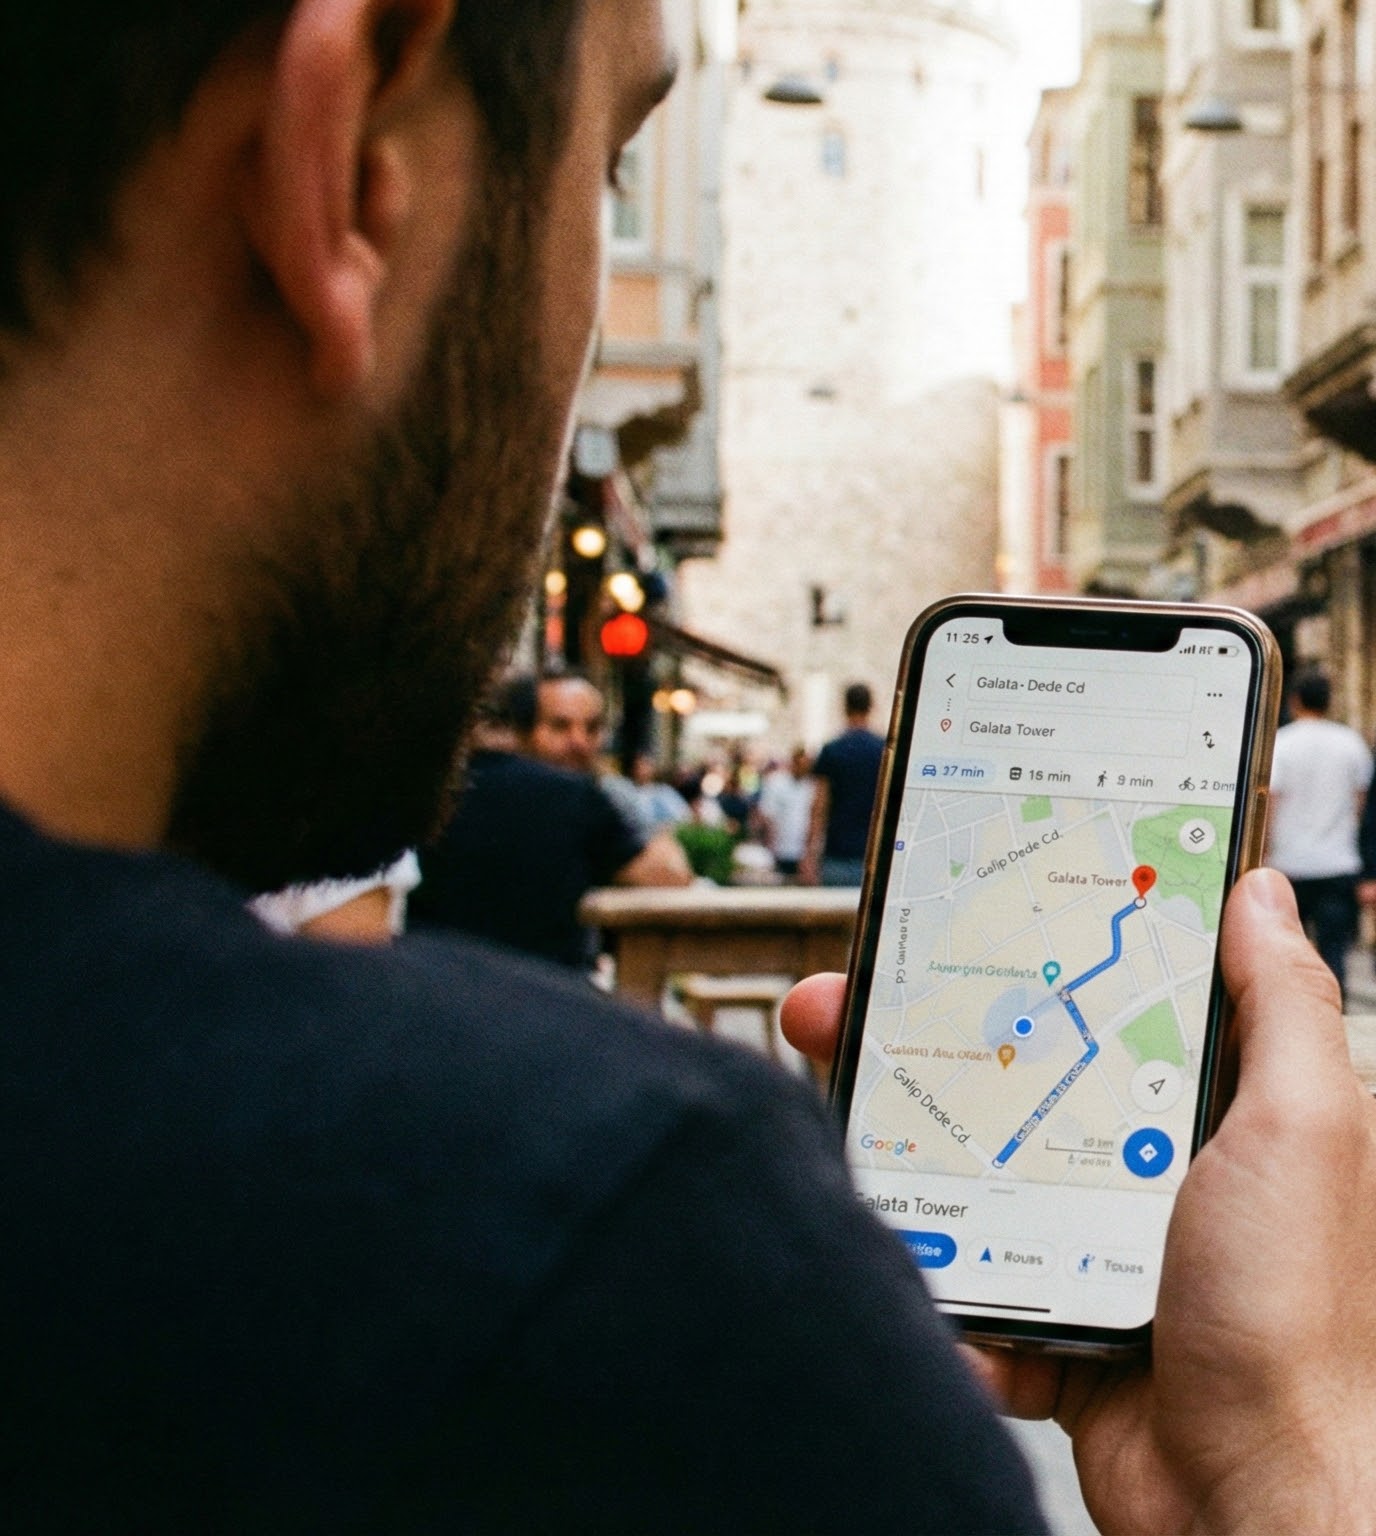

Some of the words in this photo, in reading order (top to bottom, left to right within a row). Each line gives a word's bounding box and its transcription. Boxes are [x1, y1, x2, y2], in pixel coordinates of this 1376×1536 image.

[1028, 679, 1062, 693] Dede
[1066, 682, 1085, 694] Cd
[970, 721, 1012, 735] Galata
[1016, 723, 1056, 737] Tower
[961, 766, 985, 778] min
[1047, 770, 1071, 782] min
[1129, 775, 1153, 788] min
[1008, 841, 1040, 863] Dede
[1047, 871, 1088, 885] Galata
[1091, 873, 1128, 887] Tower
[920, 1094, 951, 1128] Dede
[861, 1133, 917, 1156] Google
[857, 1191, 908, 1214] alata
[914, 1197, 969, 1218] Tower
